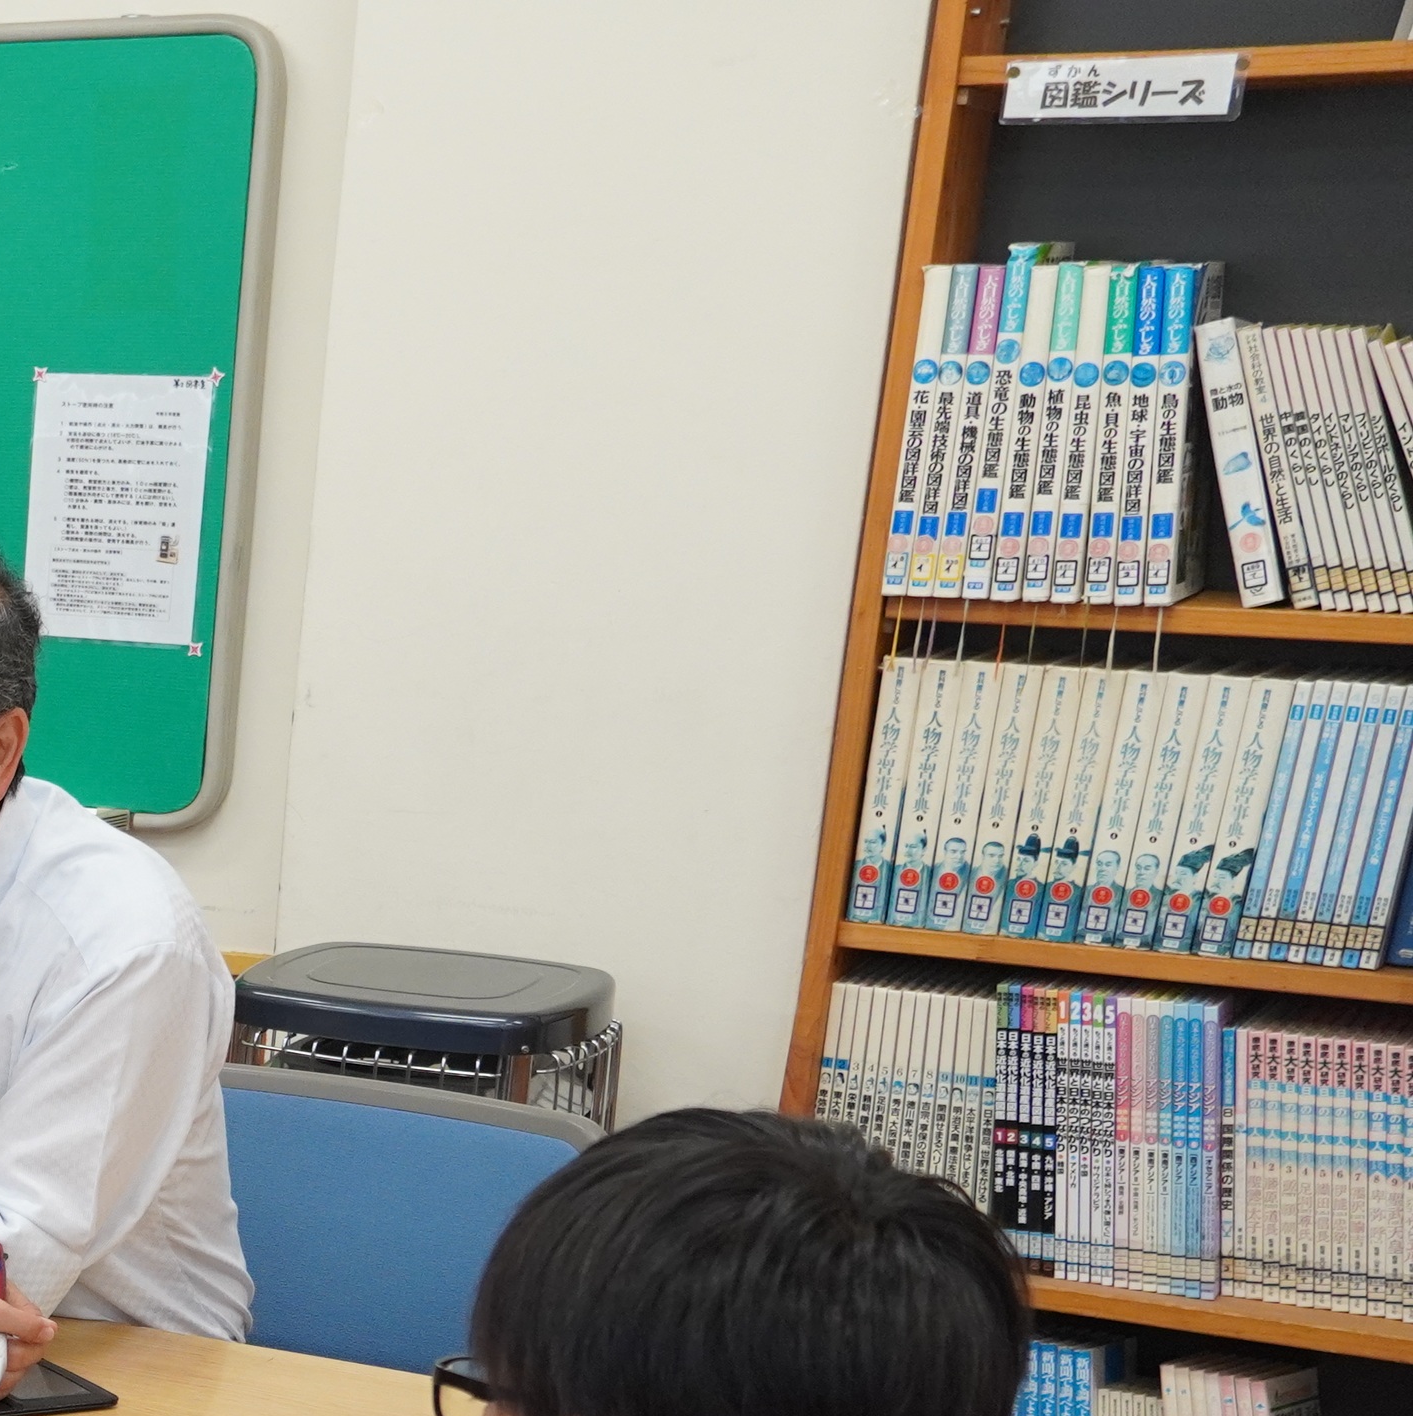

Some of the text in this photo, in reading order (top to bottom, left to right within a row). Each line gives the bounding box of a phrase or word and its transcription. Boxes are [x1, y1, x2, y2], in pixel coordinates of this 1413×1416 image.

[1040, 79, 1206, 109] 図鑑シリーズ
[1048, 64, 1100, 78] ずかん
[982, 370, 1012, 479] 恐竜の生態図鑑
[1156, 393, 1179, 484] 鳥の生態図鑑
[1212, 392, 1244, 412] 動物
[923, 392, 954, 514] 最先端技術の図詳図
[951, 392, 982, 511] 道具・機械の図詳図
[1009, 393, 1036, 499] 動物の生態図鑑
[1037, 389, 1064, 495] 植物の生態図鑑
[1064, 394, 1091, 500] 昆虫の生態図鑑
[1097, 392, 1121, 502] 魚・貝の生態図鑑
[1125, 394, 1149, 515] 地球・宇宙の図詳図
[1260, 414, 1293, 525] 世界の自然と生活
[1280, 412, 1305, 486] 中国のくらし
[1310, 413, 1335, 487] タイのくらし
[1323, 413, 1354, 510] インドネシアのくらし
[1339, 414, 1368, 502] マレーシアのくらし
[872, 706, 901, 810] 人物学習事典
[913, 711, 942, 814] 人物学習事典
[951, 713, 981, 817] 人物学習事典
[988, 715, 1021, 821] 人物学習事典
[1029, 719, 1061, 824] 人物学習事典
[1067, 721, 1100, 827] 人物学習事典
[1108, 726, 1142, 832] 人物学習事典
[1147, 729, 1182, 836] 人物学習事典
[1188, 729, 1222, 836] 人物学習事典
[1226, 731, 1264, 838] 人物学習事典
[1059, 1001, 1066, 1019] 1
[1070, 1002, 1080, 1020] 2
[1082, 1002, 1092, 1021] 3
[1093, 1004, 1103, 1023] 4
[1056, 1057, 1067, 1152] 世界と日本のつながり
[1068, 1058, 1080, 1153] 世界と日本のつながり
[1080, 1060, 1091, 1154] 世界と日本のつながり
[1091, 1062, 1103, 1156] 世界と日本のつながり
[1103, 1005, 1115, 1157] 5 世界と日本のつながり
[1116, 1076, 1128, 1105] アジア
[1131, 1077, 1142, 1106] アジア
[1146, 1079, 1157, 1109] アジア
[1160, 1080, 1171, 1110] アジア
[1174, 1082, 1186, 1112] アジア
[1188, 1083, 1201, 1113] アジア
[1204, 1085, 1215, 1116] アジア
[933, 1104, 946, 1174] 開国せまるペリー
[996, 1132, 1002, 1141] 1
[1007, 1132, 1016, 1142] 2
[1020, 1135, 1029, 1144] 3
[1032, 1136, 1041, 1146] 4
[1045, 1138, 1054, 1147] 5
[1253, 1161, 1257, 1169] 1
[1269, 1163, 1274, 1171] 2
[1302, 1168, 1308, 1176] 4
[1319, 1169, 1326, 1178] 5
[1337, 1170, 1343, 1178] 6
[1355, 1173, 1361, 1181] 7
[1373, 1175, 1379, 1183] 8
[1391, 1178, 1398, 1186] 9
